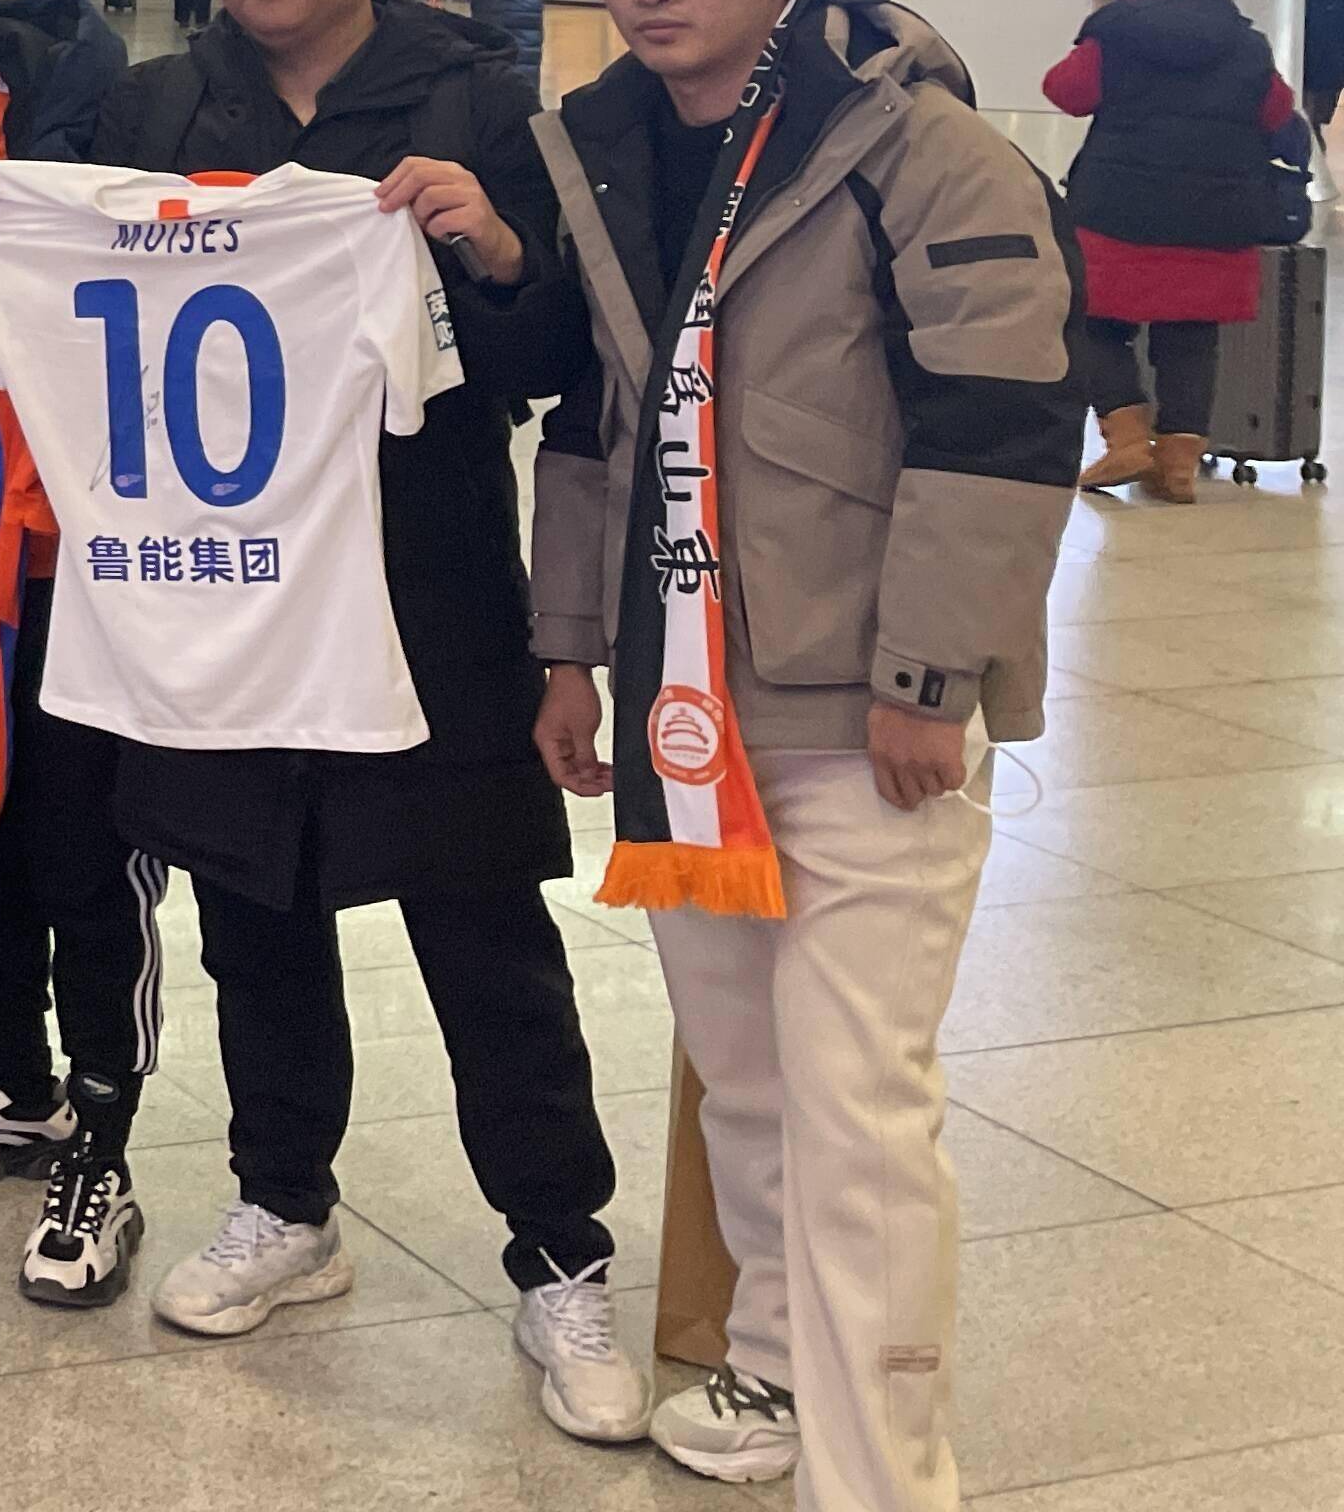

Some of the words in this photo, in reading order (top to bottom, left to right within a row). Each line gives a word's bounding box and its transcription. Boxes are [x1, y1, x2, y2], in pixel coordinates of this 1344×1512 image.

[110, 219, 243, 253] MOISES
[73, 278, 287, 508] 10
[86, 534, 281, 584] 鲁能集团
